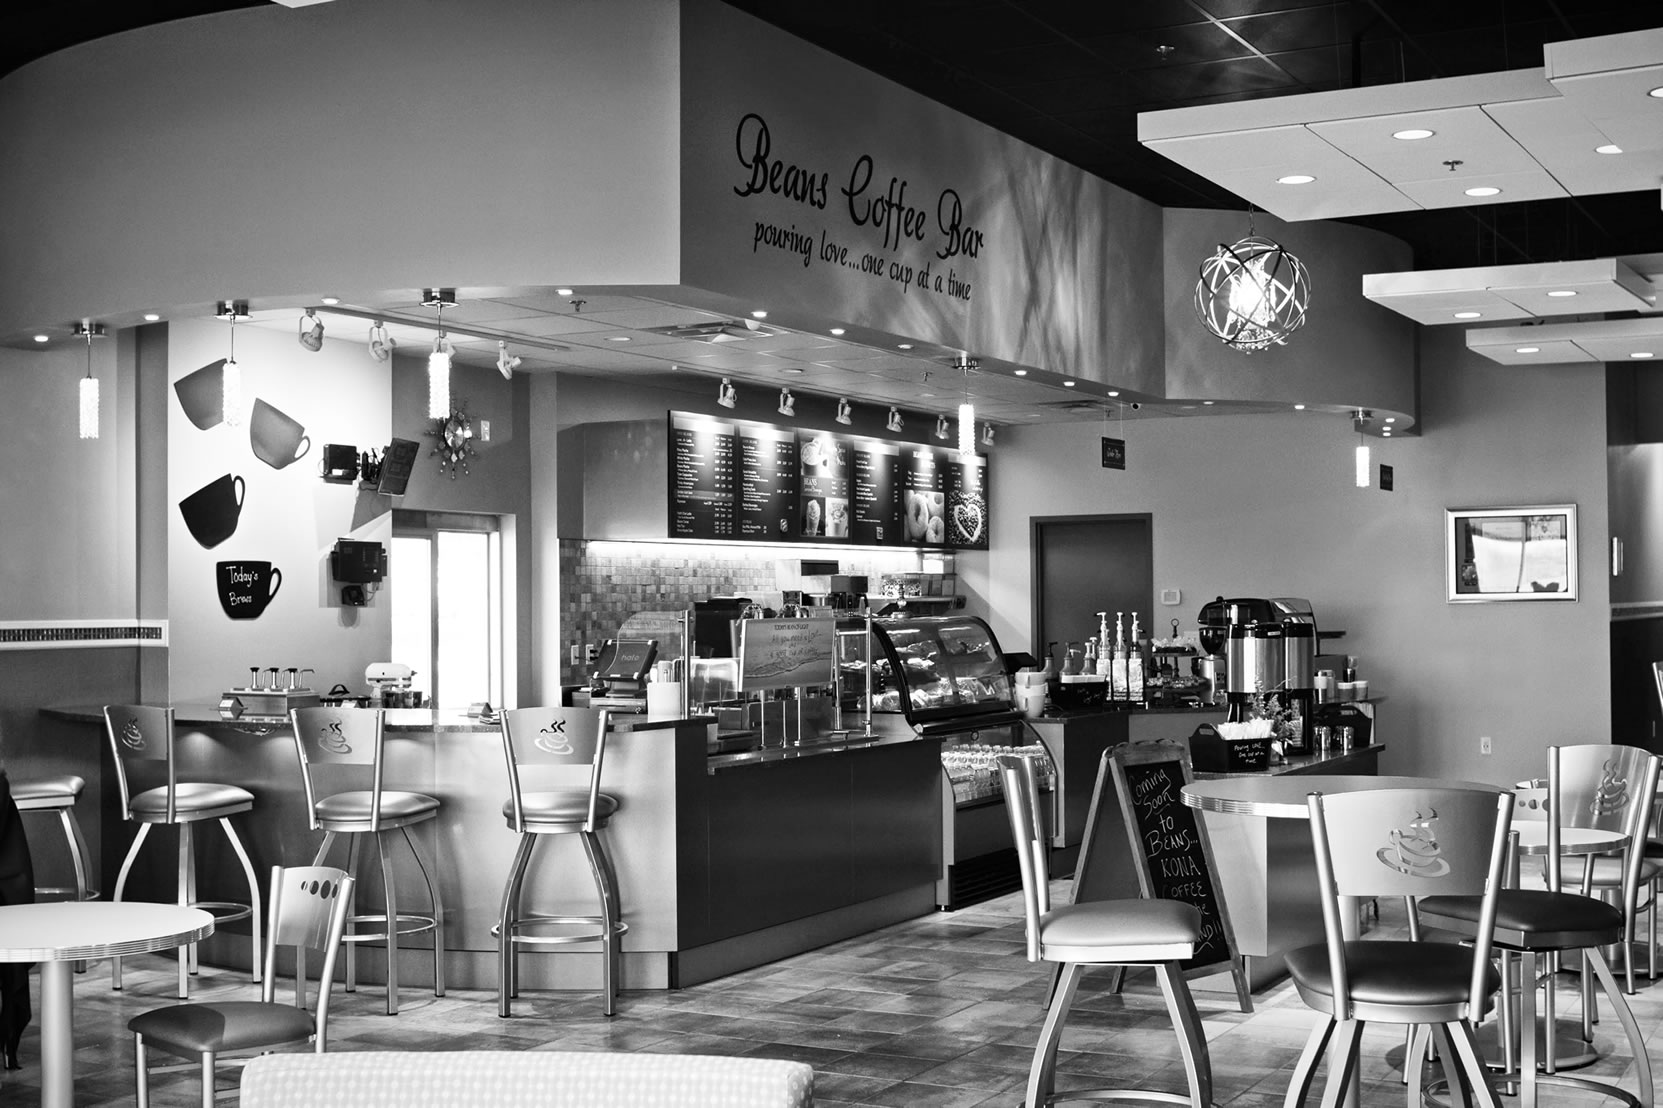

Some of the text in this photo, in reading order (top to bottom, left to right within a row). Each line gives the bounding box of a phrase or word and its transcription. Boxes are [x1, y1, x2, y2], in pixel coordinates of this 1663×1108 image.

[733, 113, 984, 260] Beans Coffee Bar
[753, 221, 813, 268] pouring
[889, 260, 913, 294] cup
[917, 261, 930, 290] at
[934, 274, 943, 293] a
[947, 268, 971, 301] time
[225, 565, 259, 588] Today's
[1129, 768, 1172, 806] Coming
[1159, 814, 1174, 833] to
[1160, 855, 1201, 879] KONA
